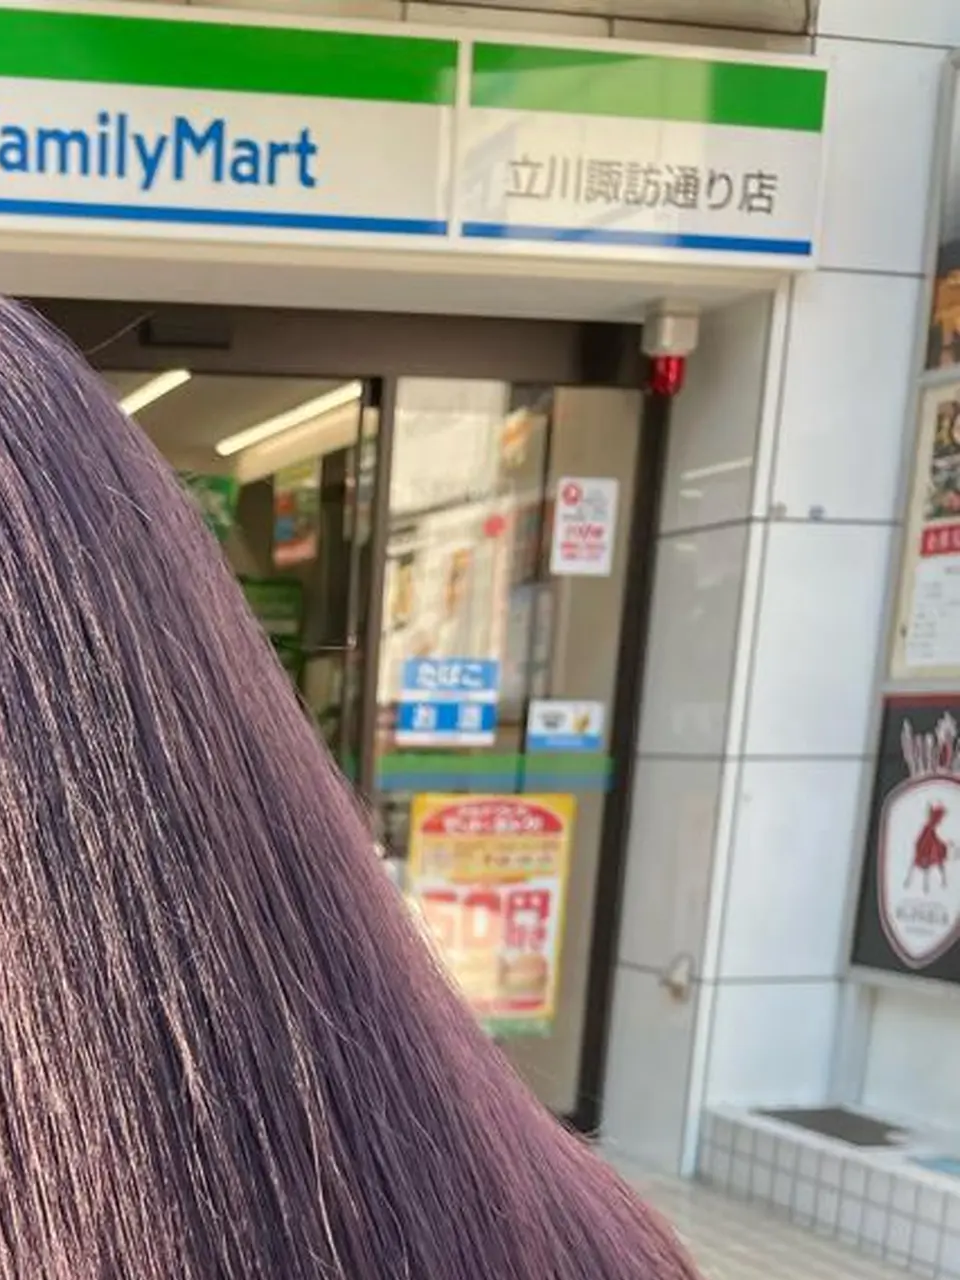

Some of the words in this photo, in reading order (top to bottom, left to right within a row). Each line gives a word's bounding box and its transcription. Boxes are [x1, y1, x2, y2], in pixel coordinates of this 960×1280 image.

[505, 153, 779, 215] 立川諏訪通り店
